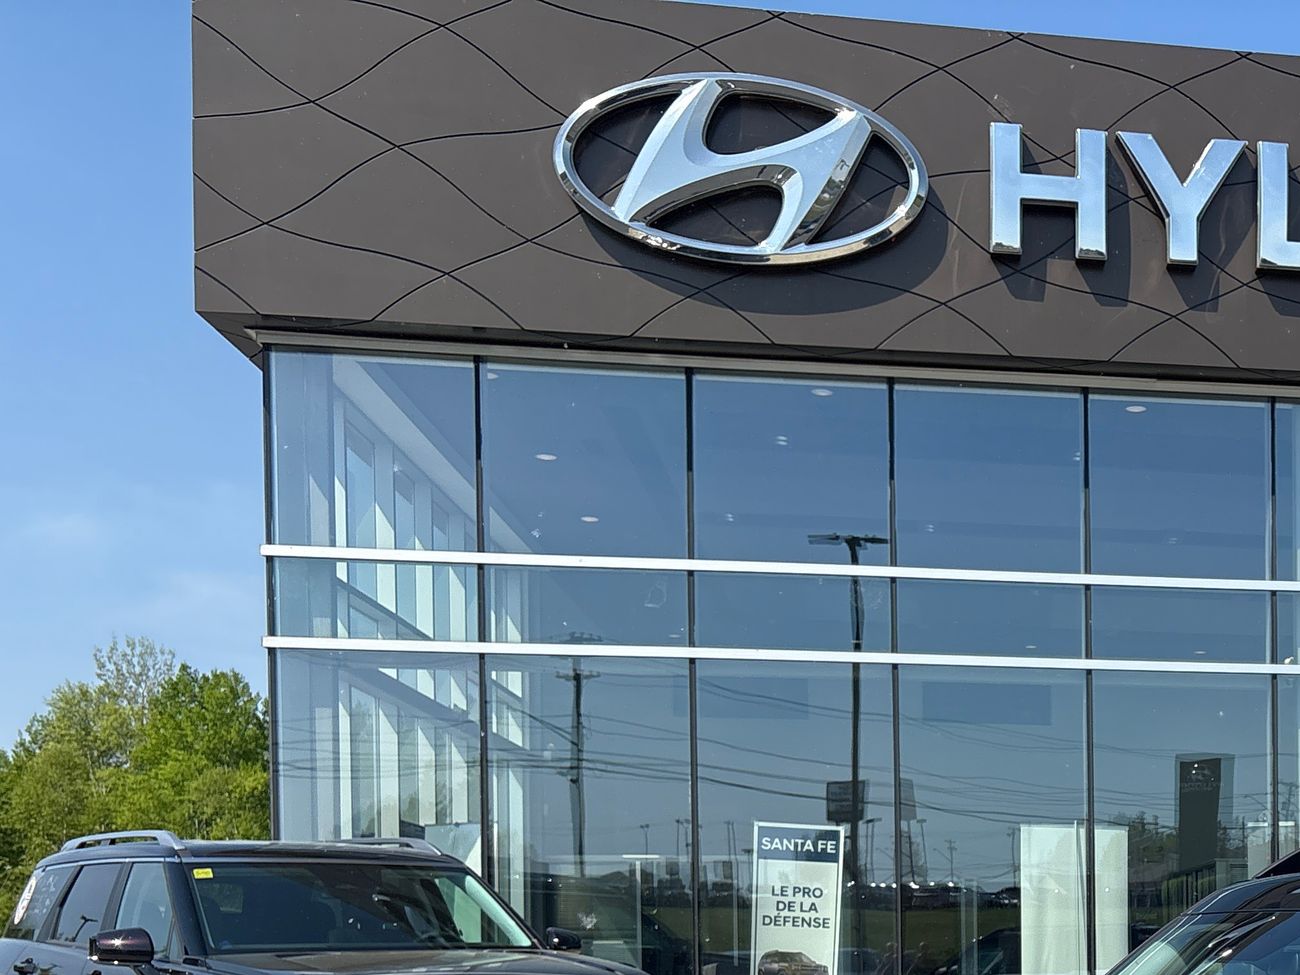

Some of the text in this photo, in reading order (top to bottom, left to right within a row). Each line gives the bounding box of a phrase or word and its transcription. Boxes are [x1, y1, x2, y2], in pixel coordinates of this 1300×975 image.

[761, 836, 837, 854] SANTA FE
[771, 885, 824, 899] LE PRO
[775, 900, 819, 913] DE LA
[762, 911, 831, 929] DÉFENSE
